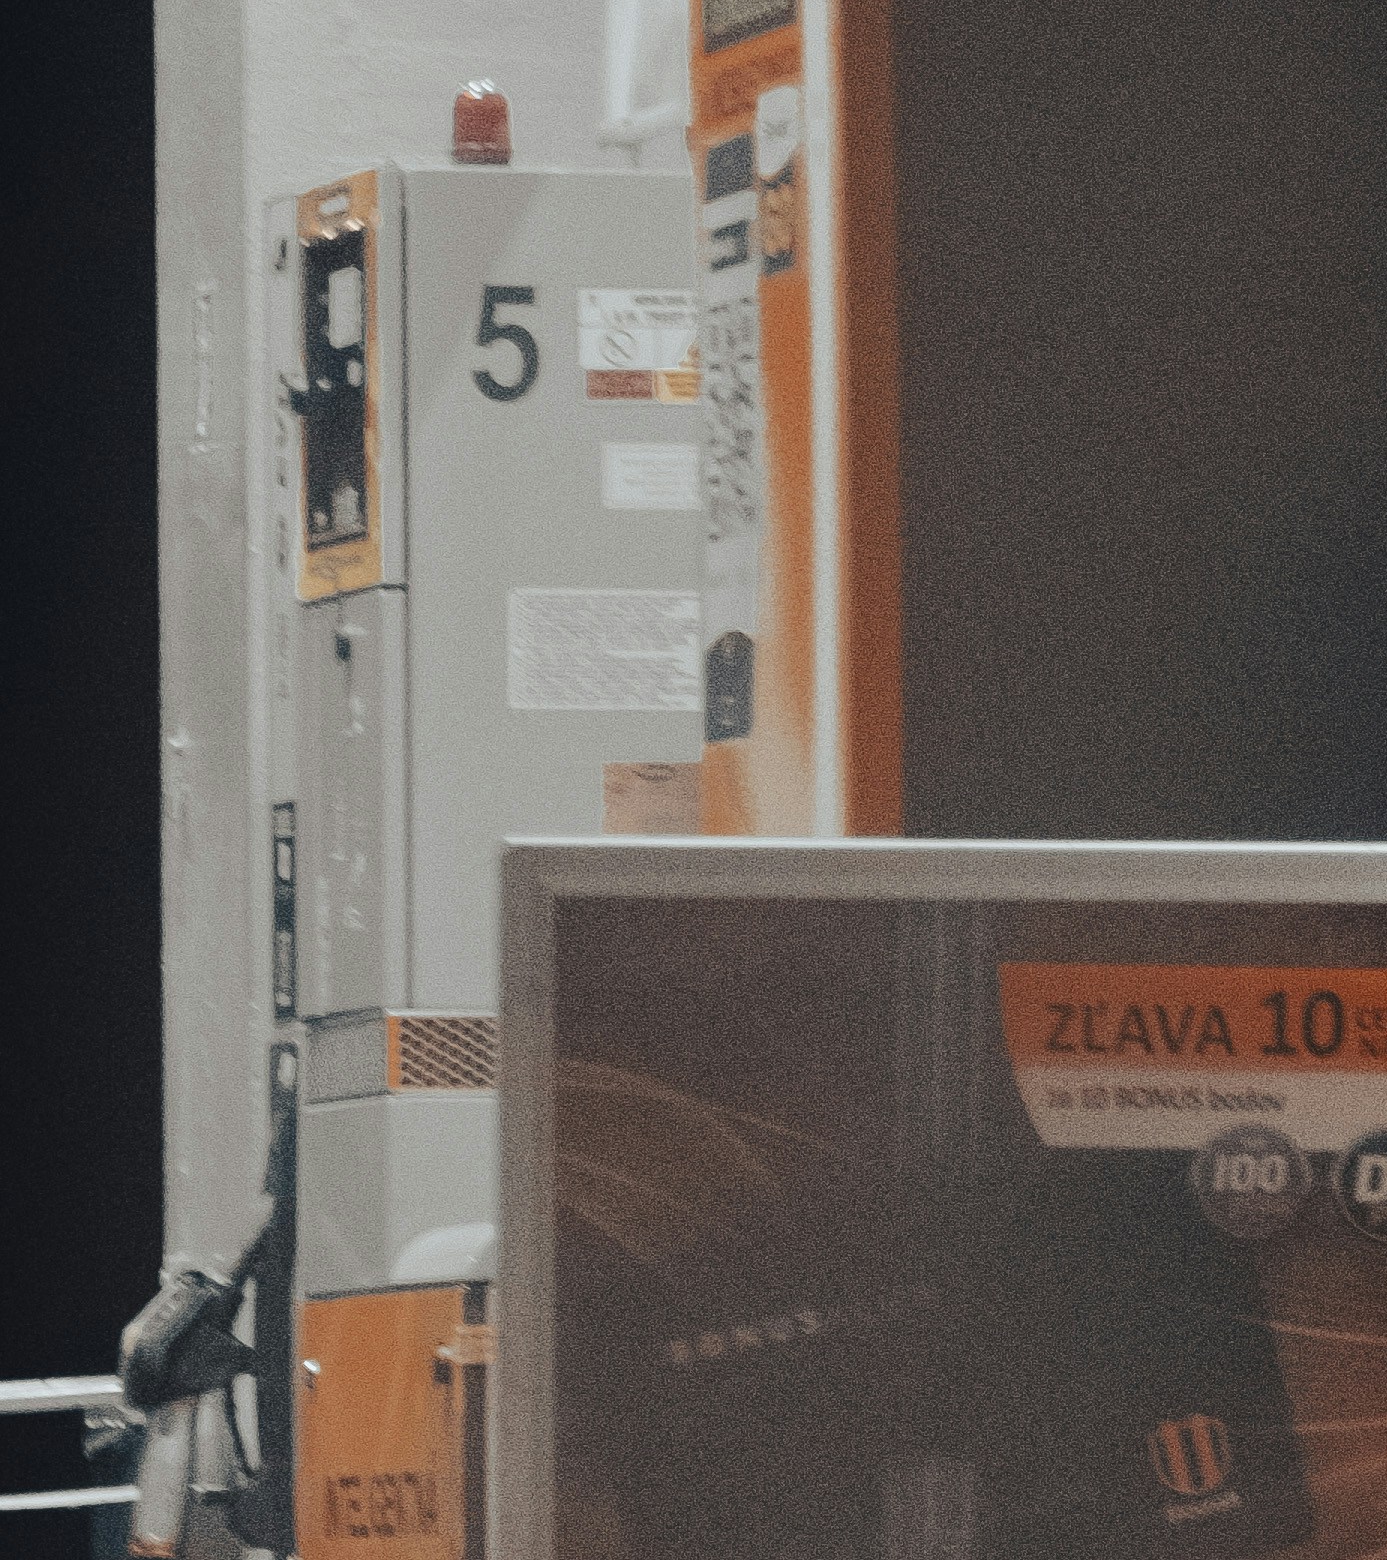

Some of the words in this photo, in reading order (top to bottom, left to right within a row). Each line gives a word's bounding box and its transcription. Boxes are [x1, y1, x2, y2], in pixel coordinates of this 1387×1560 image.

[472, 285, 541, 402] 5
[1045, 999, 1235, 1057] ZĽAVA
[1260, 990, 1345, 1058] 10
[1212, 1152, 1288, 1194] 100
